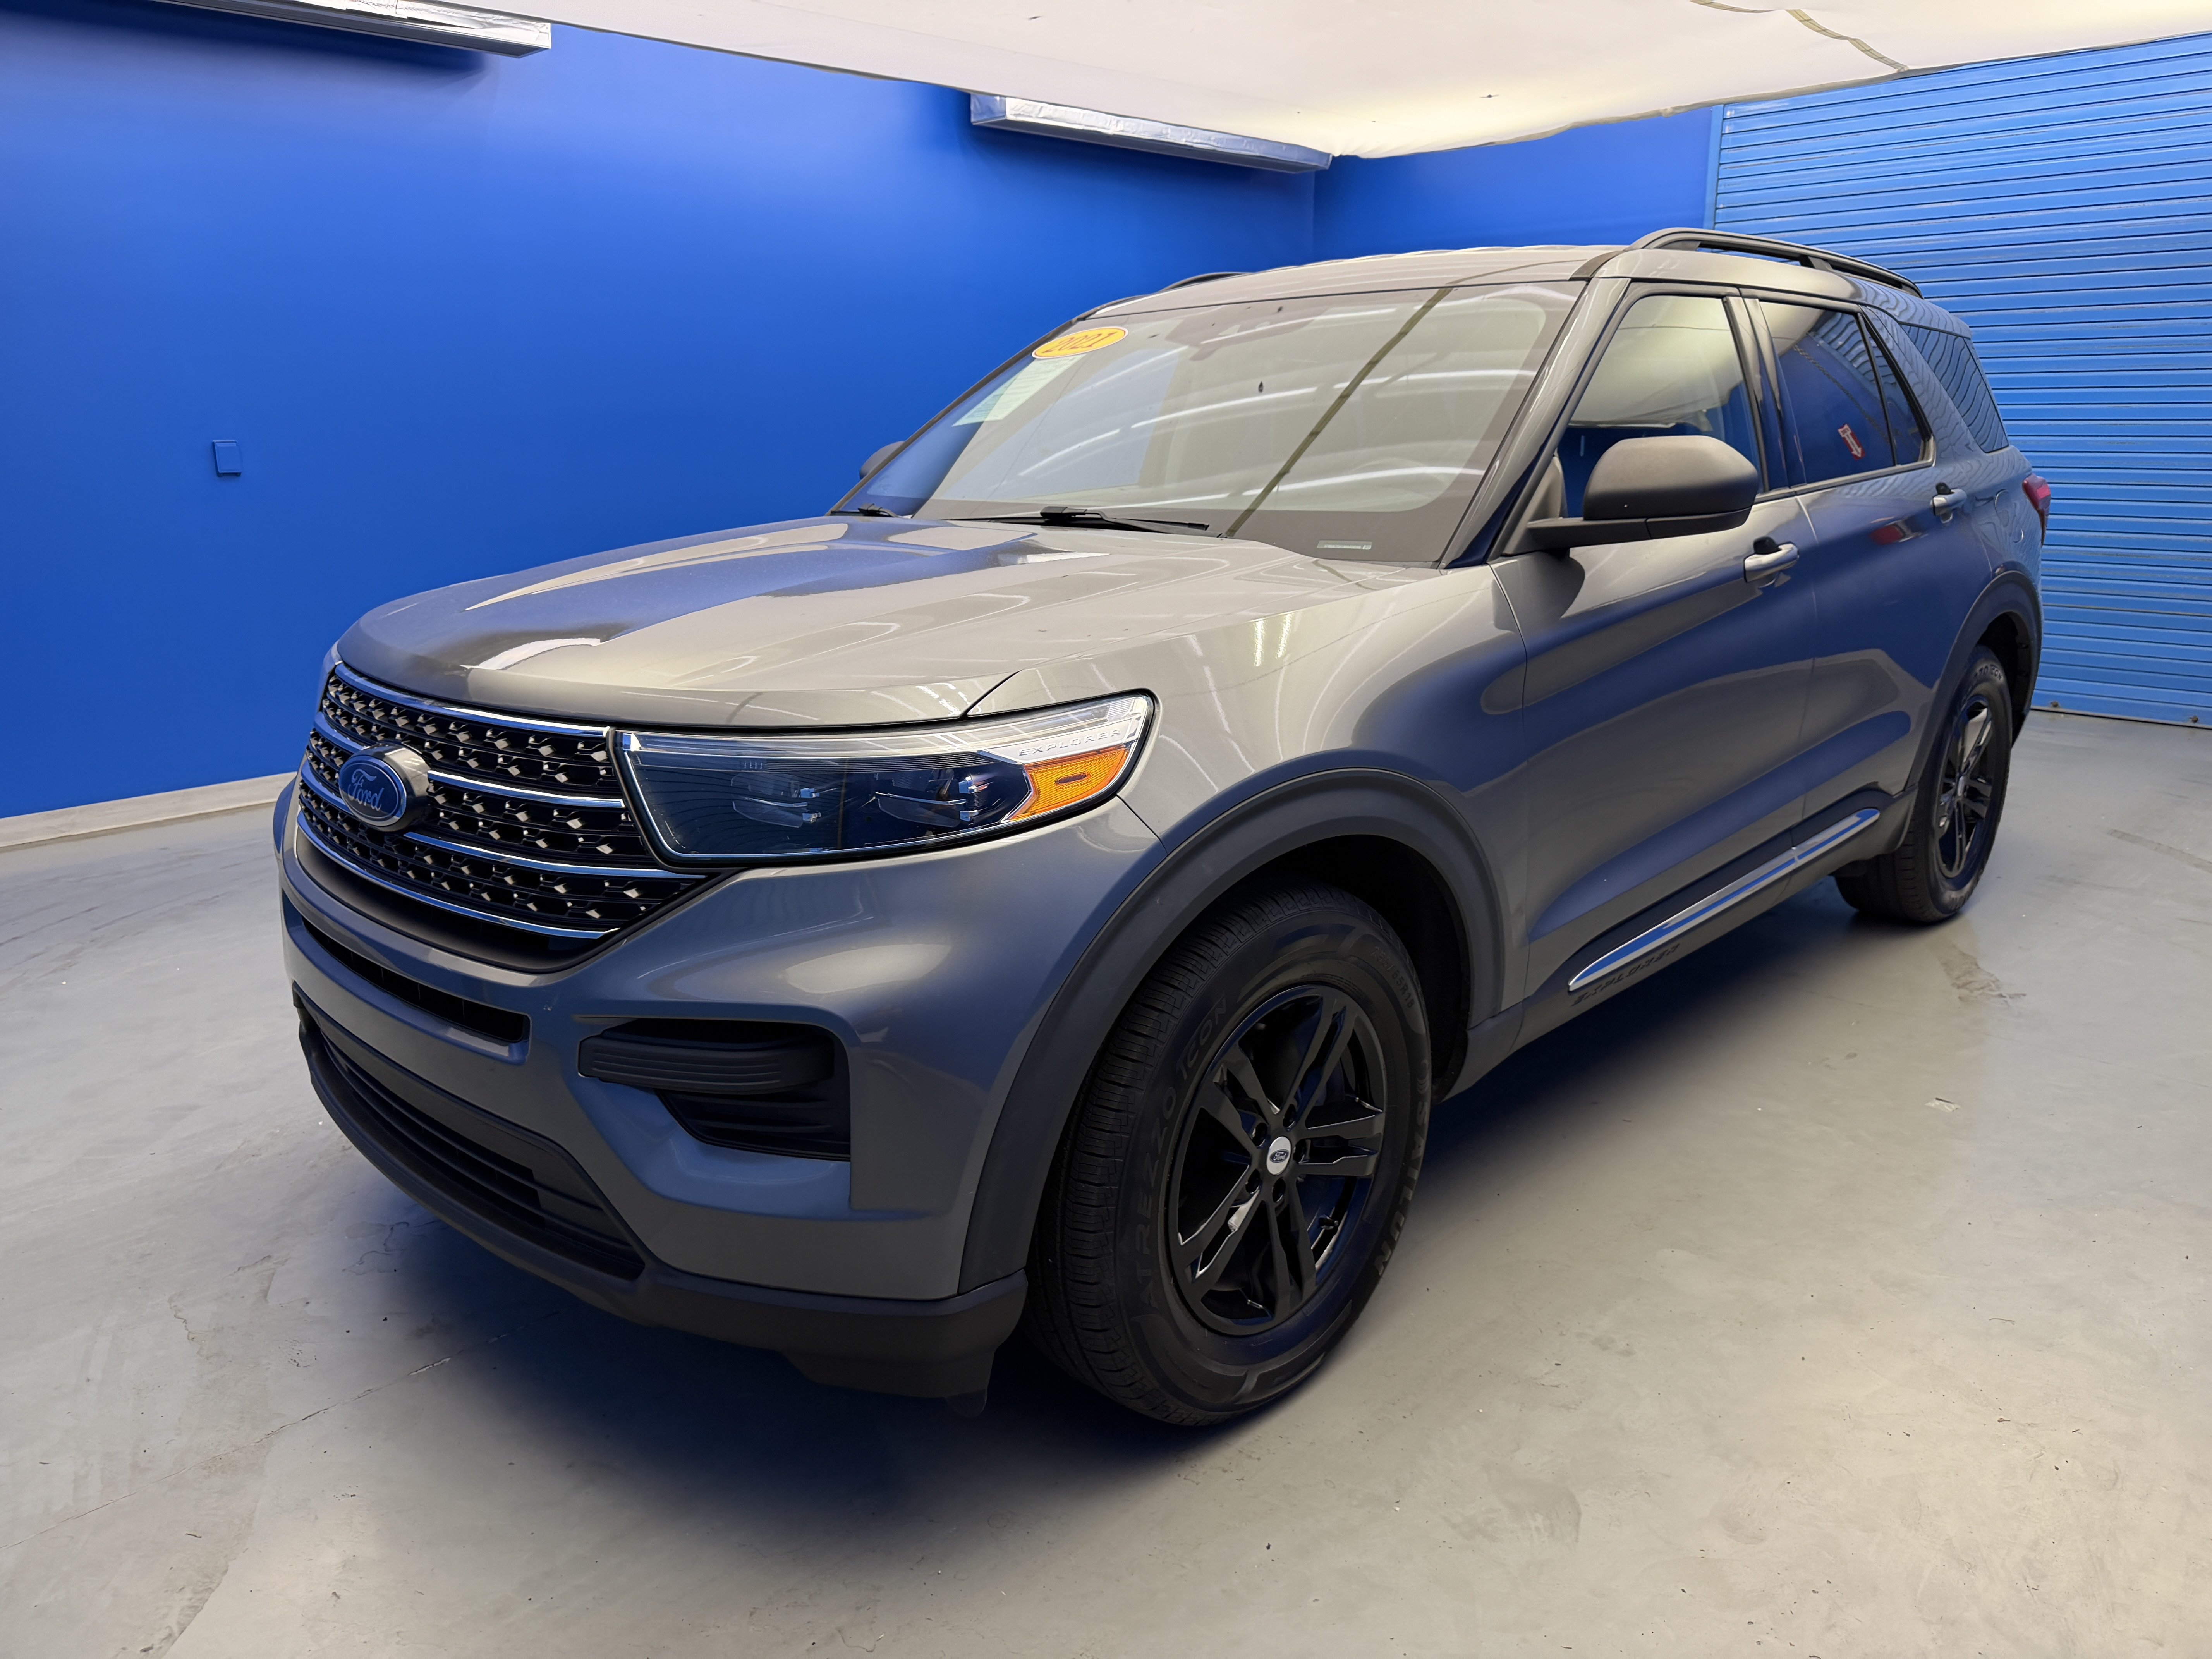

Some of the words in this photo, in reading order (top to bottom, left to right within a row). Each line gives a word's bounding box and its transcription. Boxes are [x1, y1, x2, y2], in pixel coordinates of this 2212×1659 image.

[1041, 331, 1118, 354] 2021
[1018, 728, 1122, 757] EXPLORER
[347, 768, 385, 812] Ford
[1273, 1151, 1287, 1161] Ford
[1135, 1086, 1177, 1310] ATREZZO
[1373, 1100, 1429, 1277] SAILUN
